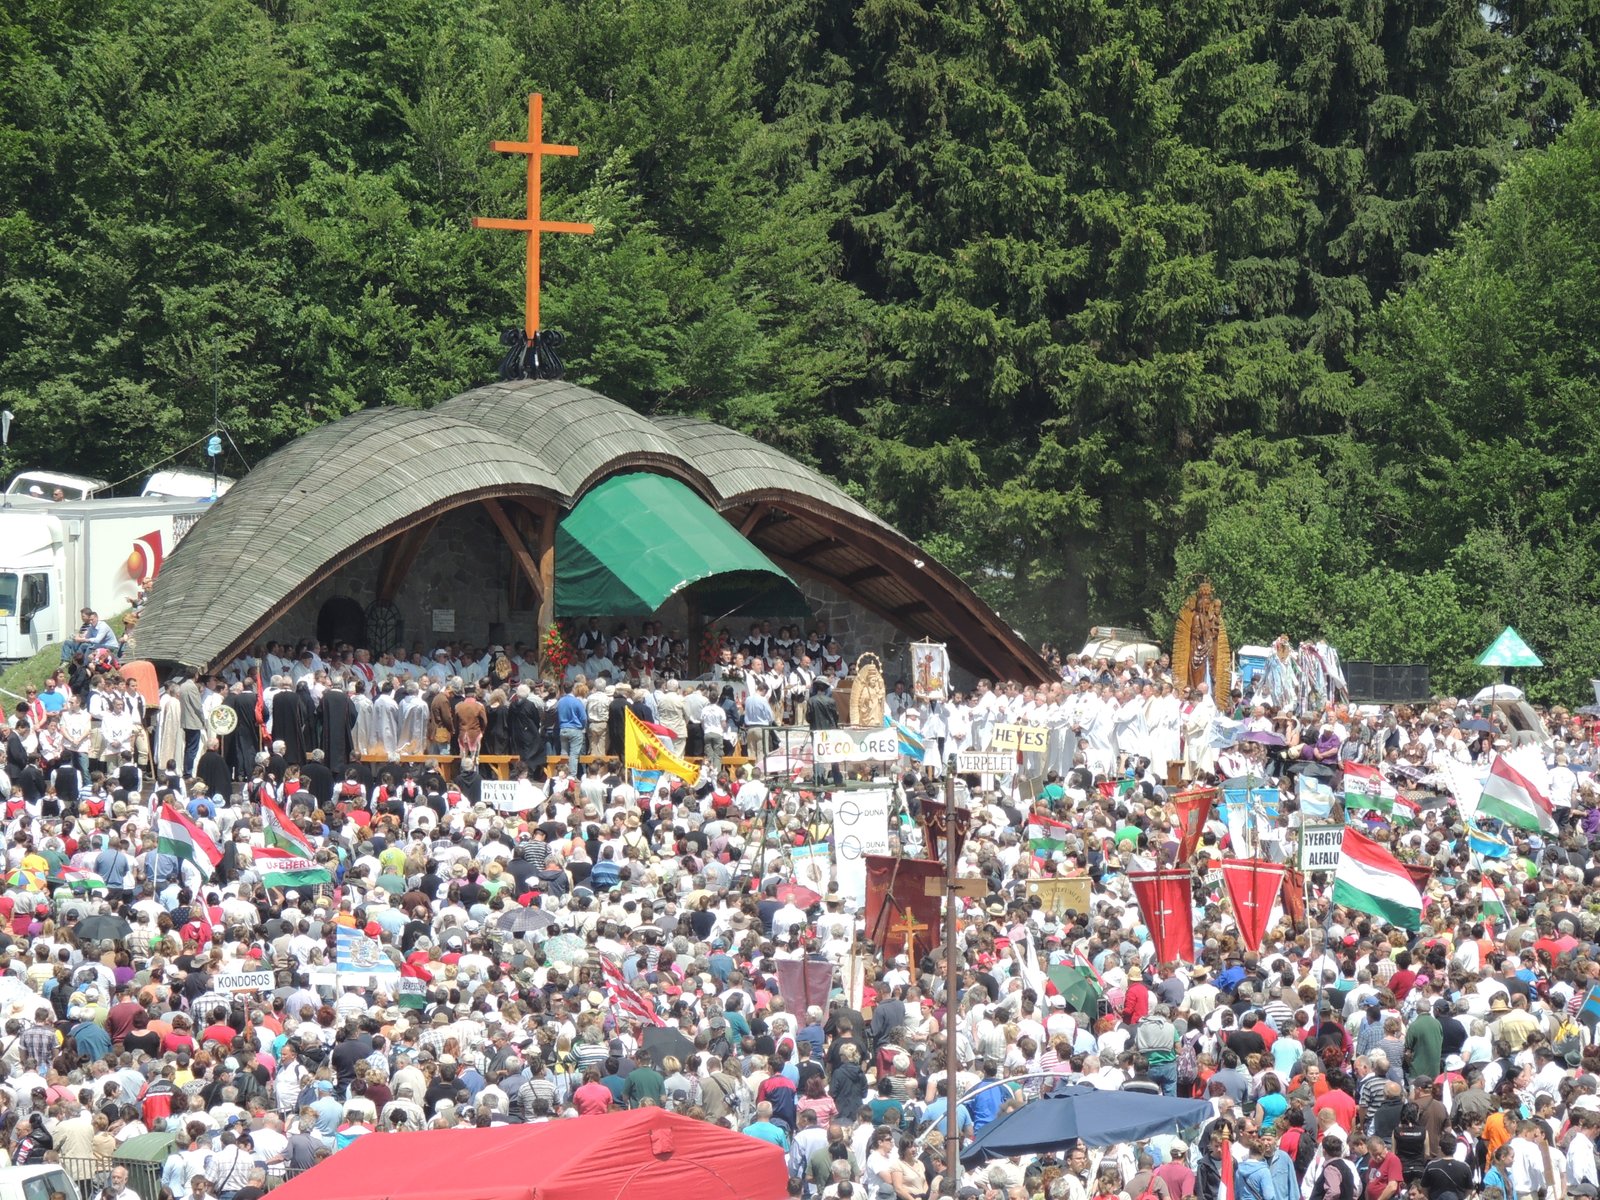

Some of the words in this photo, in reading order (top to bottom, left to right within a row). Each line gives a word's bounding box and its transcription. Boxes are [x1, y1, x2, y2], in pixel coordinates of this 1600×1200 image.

[835, 739, 895, 753] COORES
[959, 753, 1014, 770] VERPELÉT
[484, 790, 514, 801] DÁNY
[1309, 852, 1340, 865] ALFALU
[218, 974, 270, 988] KONDOROS
